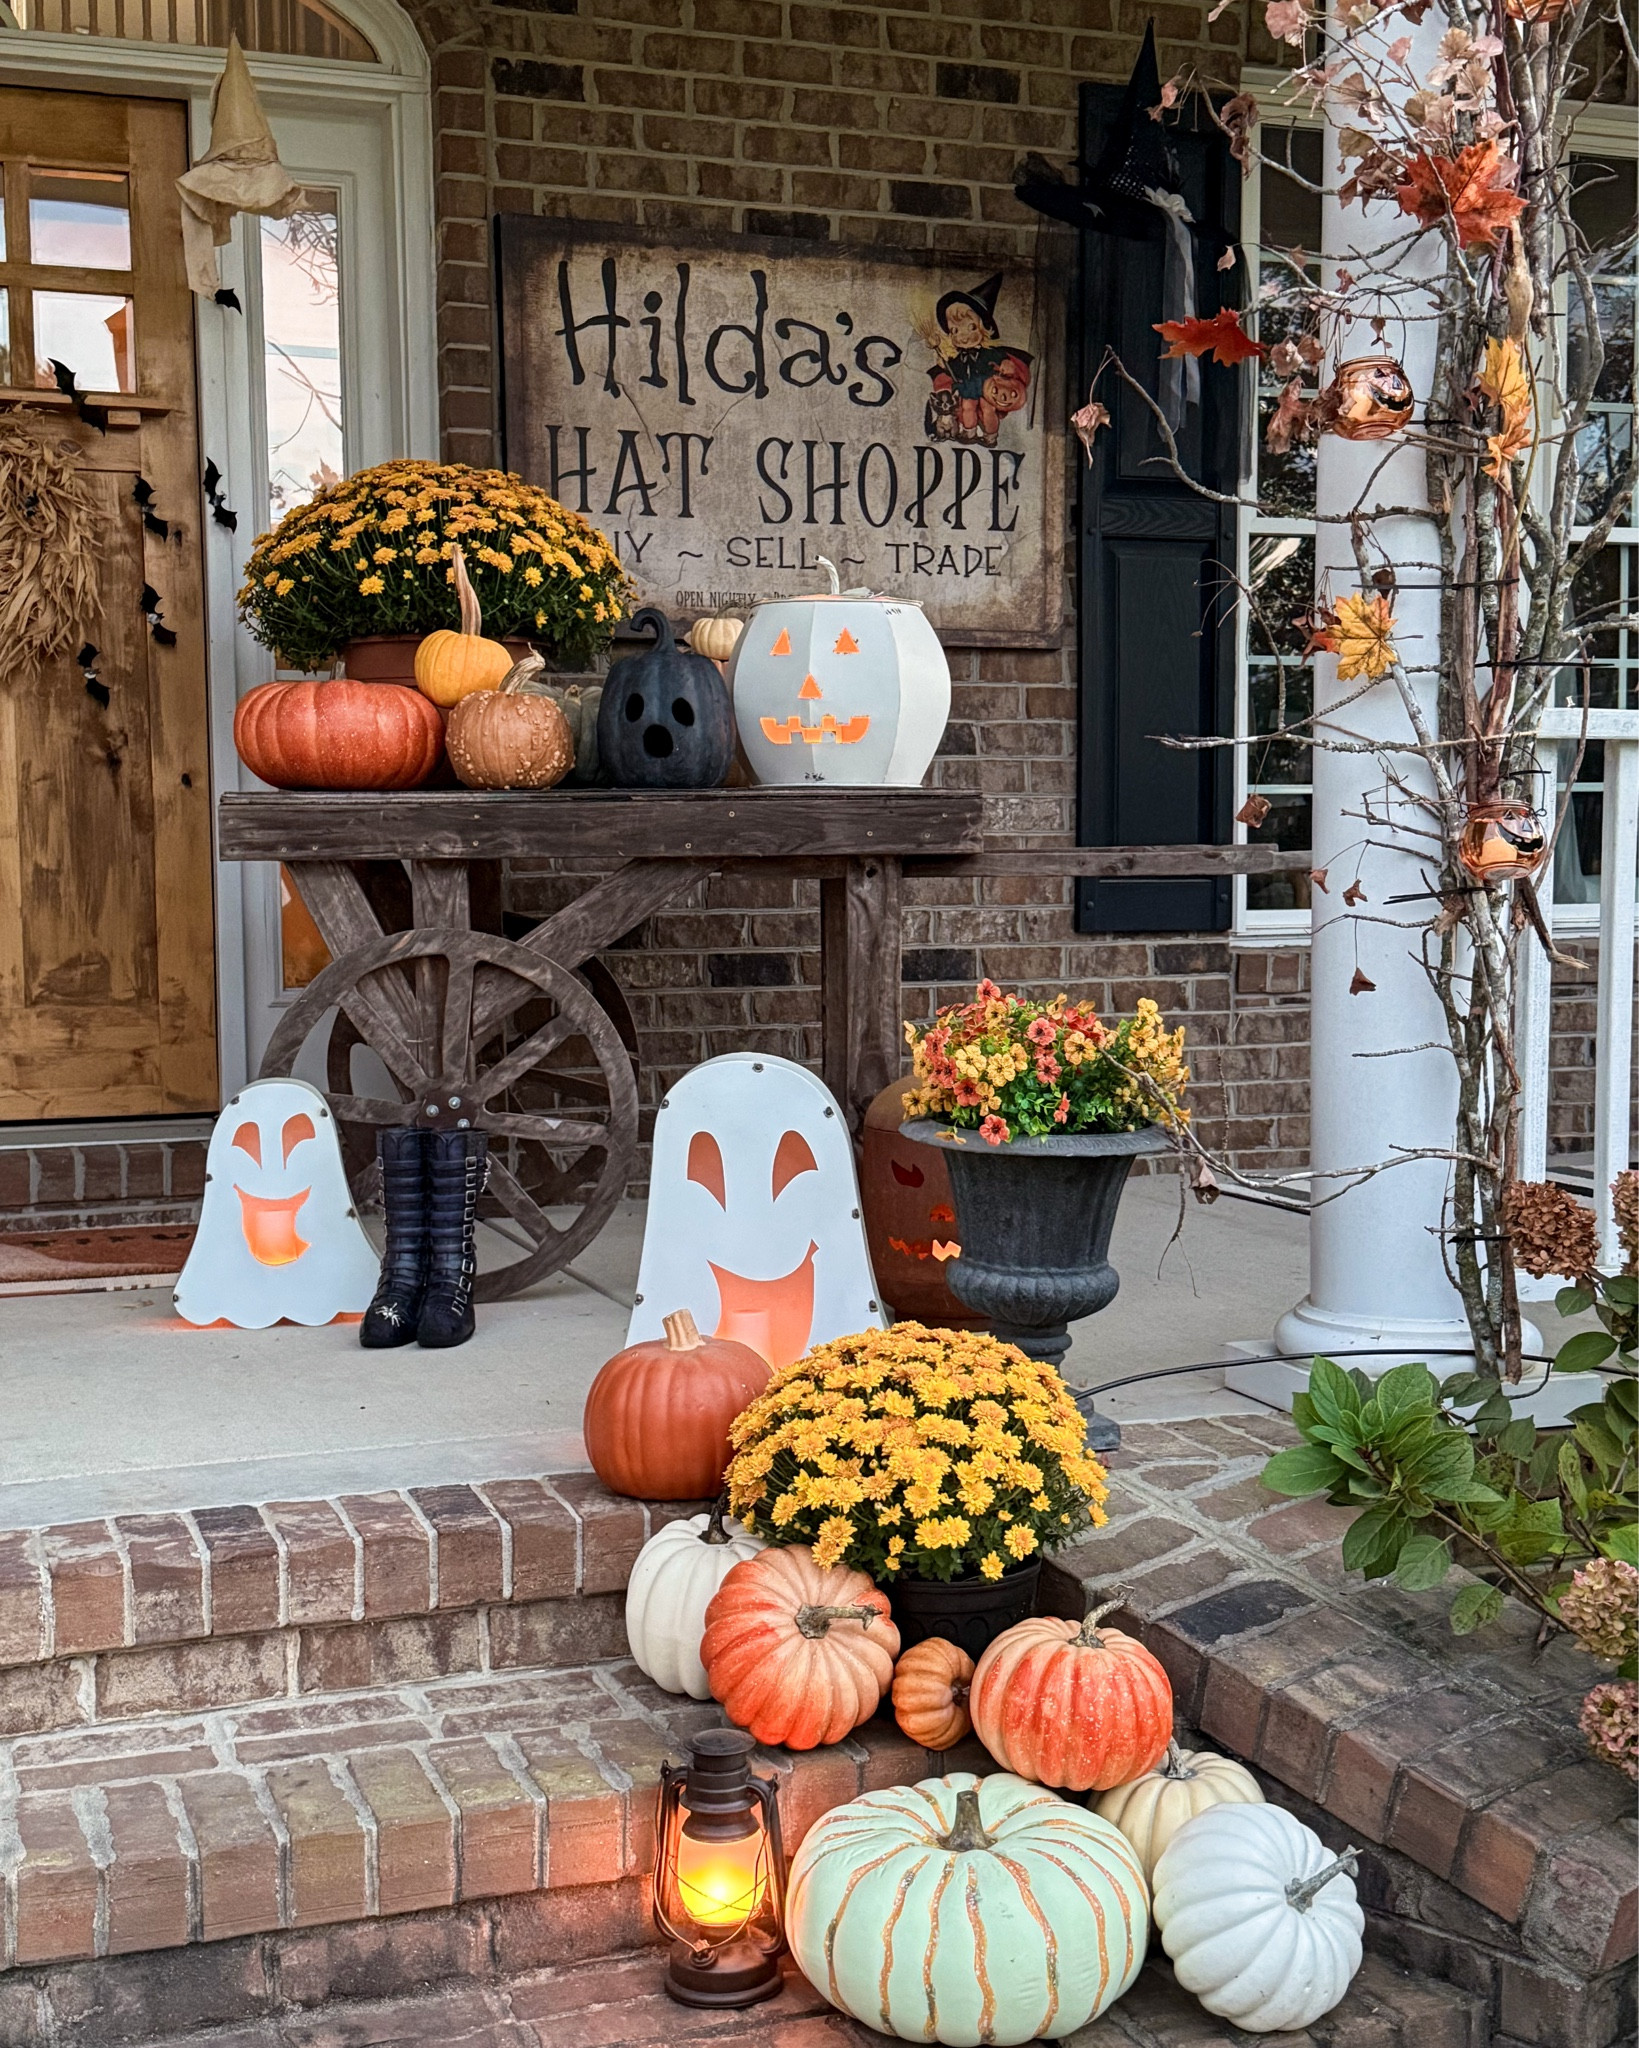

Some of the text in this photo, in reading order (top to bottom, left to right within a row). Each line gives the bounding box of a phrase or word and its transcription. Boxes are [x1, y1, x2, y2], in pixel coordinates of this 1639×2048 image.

[554, 257, 903, 407] Hilda's
[545, 424, 1026, 532] HAT SHOPPE
[726, 536, 817, 570] SELL
[885, 541, 1002, 578] TRADE
[676, 590, 704, 608] OPEN
